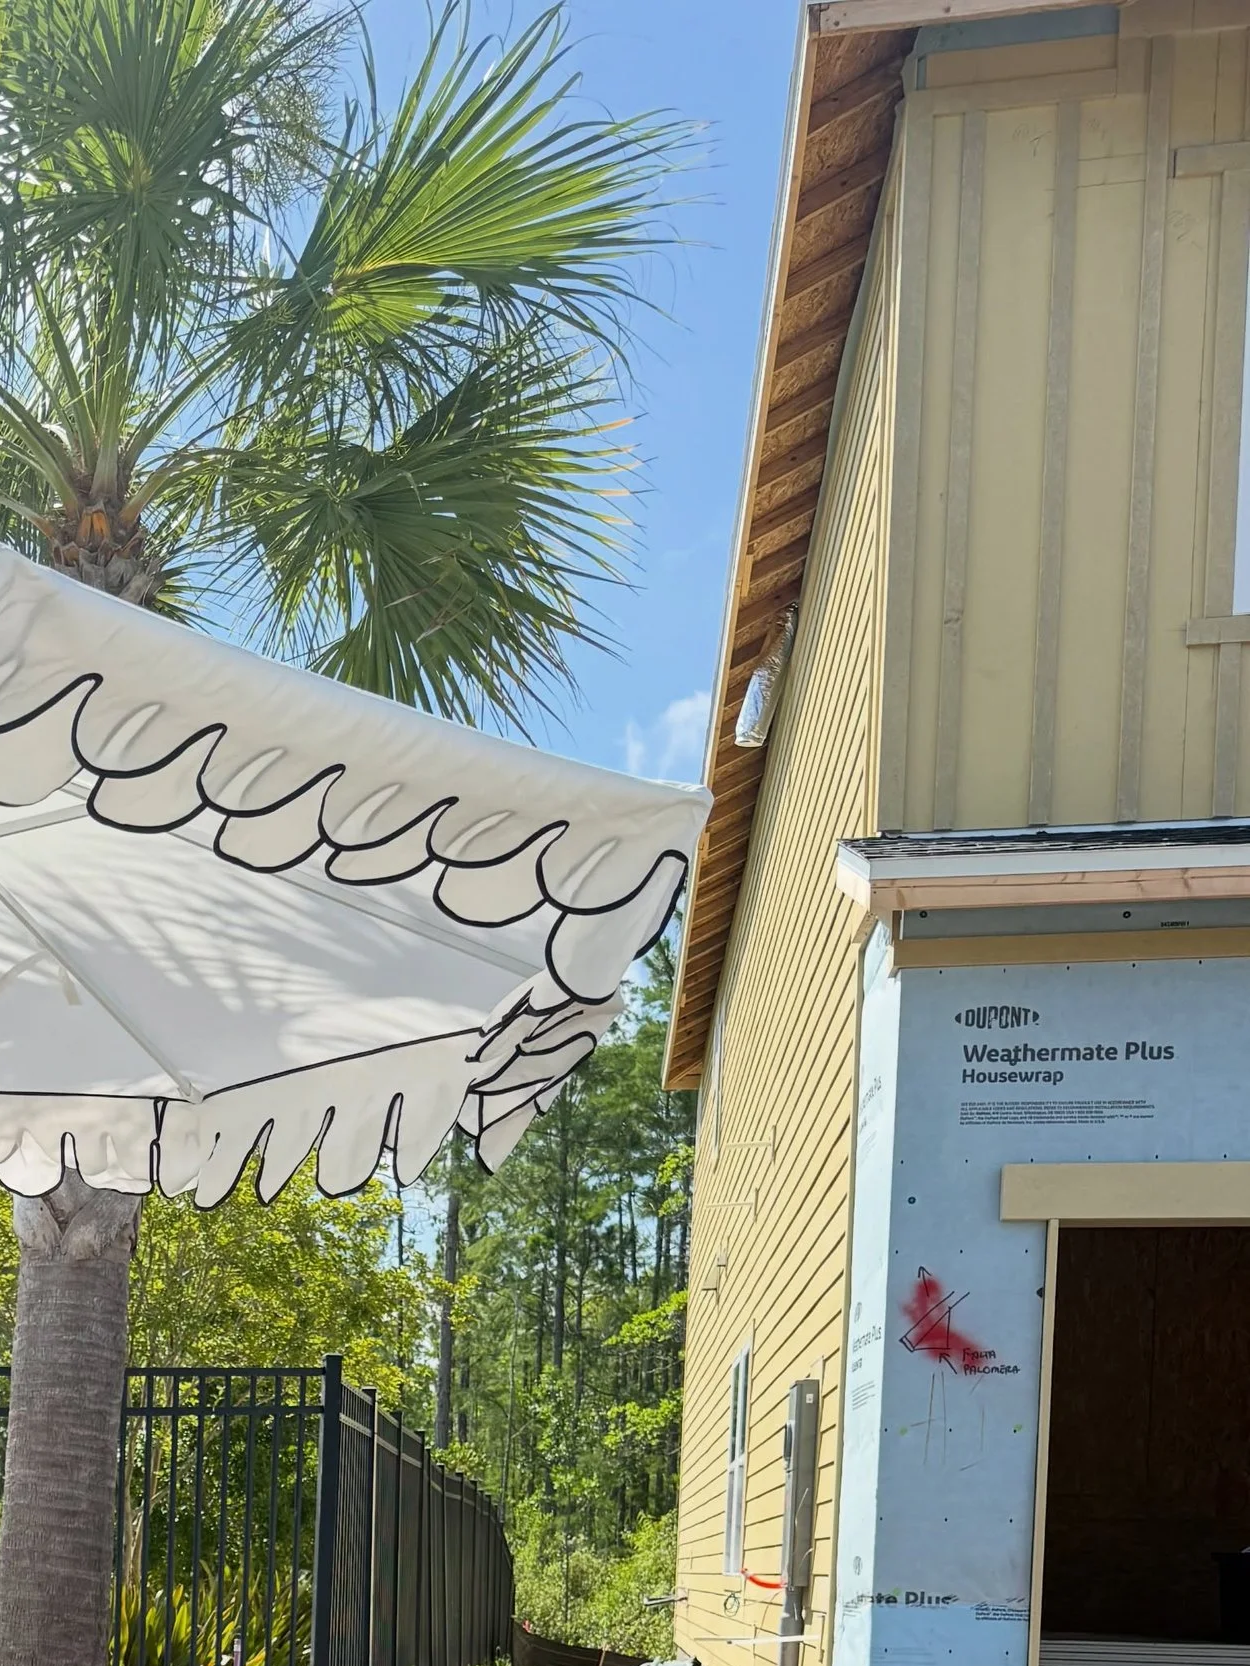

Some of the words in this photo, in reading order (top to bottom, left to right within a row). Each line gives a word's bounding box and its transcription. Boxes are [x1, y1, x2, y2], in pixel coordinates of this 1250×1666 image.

[964, 1005, 1031, 1029] DUPONT
[963, 1043, 1118, 1063] Weathermate
[1124, 1040, 1175, 1061] Plus
[961, 1068, 1064, 1085] Housewrap
